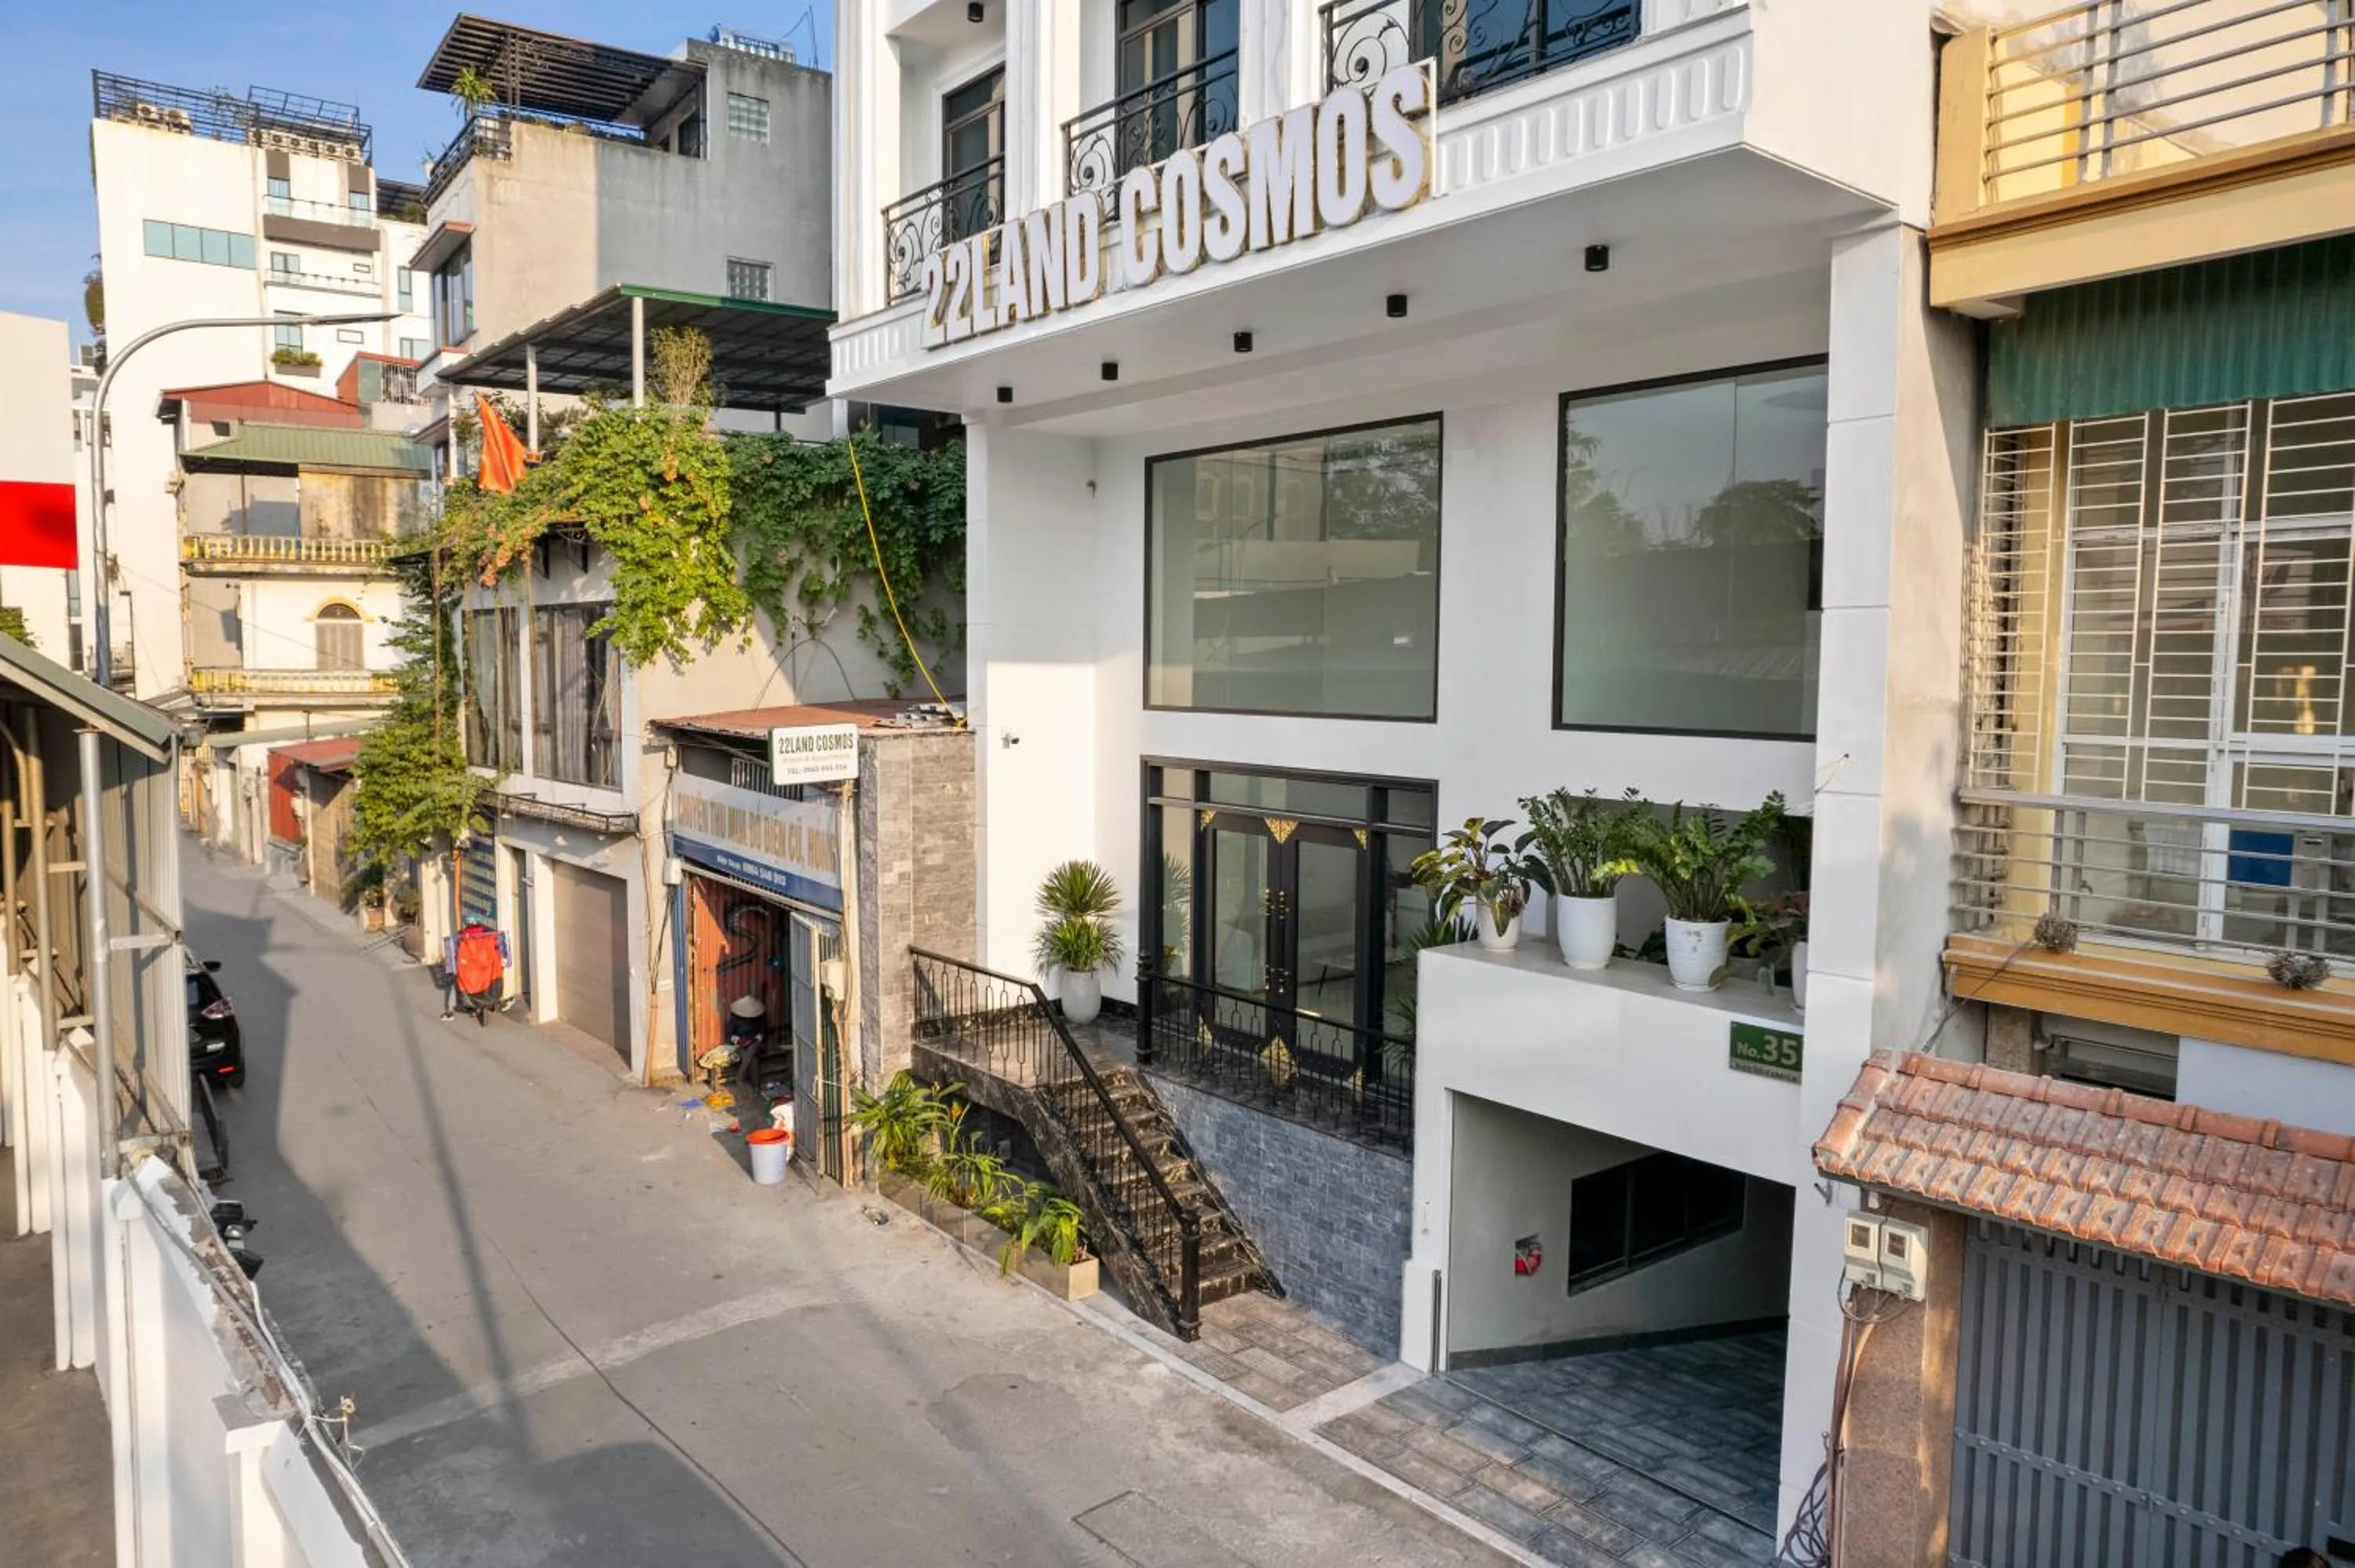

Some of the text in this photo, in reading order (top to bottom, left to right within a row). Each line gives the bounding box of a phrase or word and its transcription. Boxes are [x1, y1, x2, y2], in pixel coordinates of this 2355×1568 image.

[921, 64, 1432, 350] 22LAND COSMOS
[779, 732, 853, 754] 22LAND COSMOS
